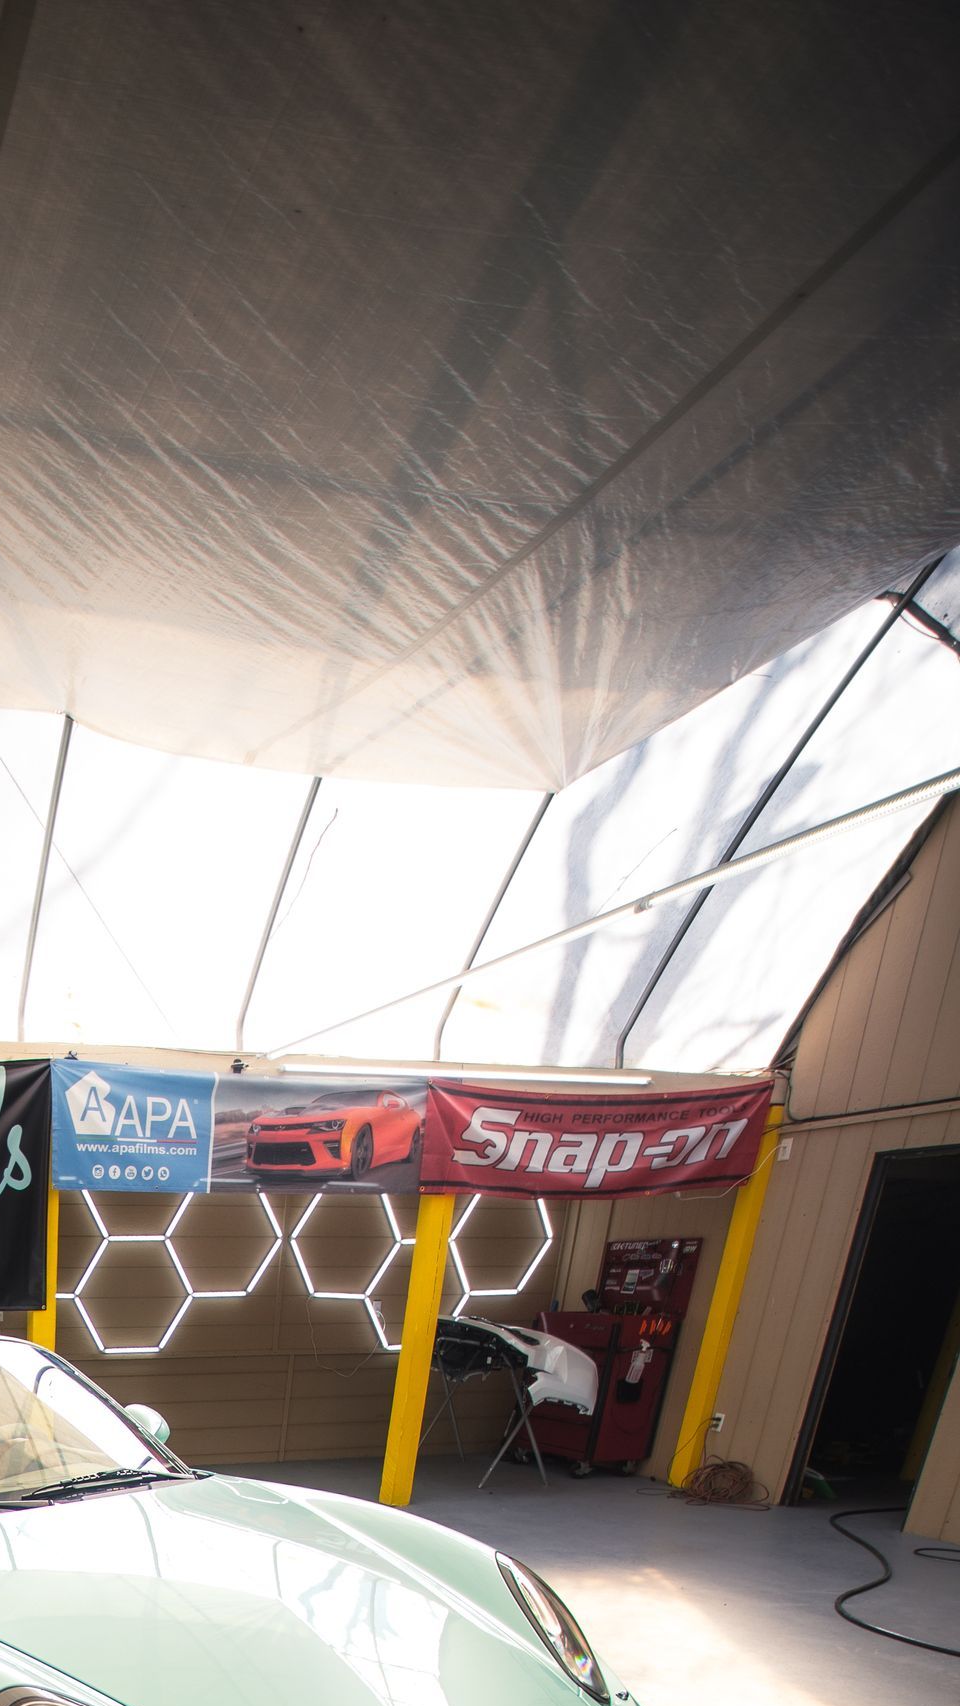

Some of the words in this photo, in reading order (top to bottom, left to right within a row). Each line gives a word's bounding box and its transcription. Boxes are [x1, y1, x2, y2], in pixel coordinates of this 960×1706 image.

[114, 1095, 198, 1139] APA
[523, 1111, 563, 1124] HIGH
[571, 1109, 690, 1124] PERFORMANCE
[76, 1143, 197, 1156] www.apafilms.com
[452, 1106, 749, 1189] Snap-on
